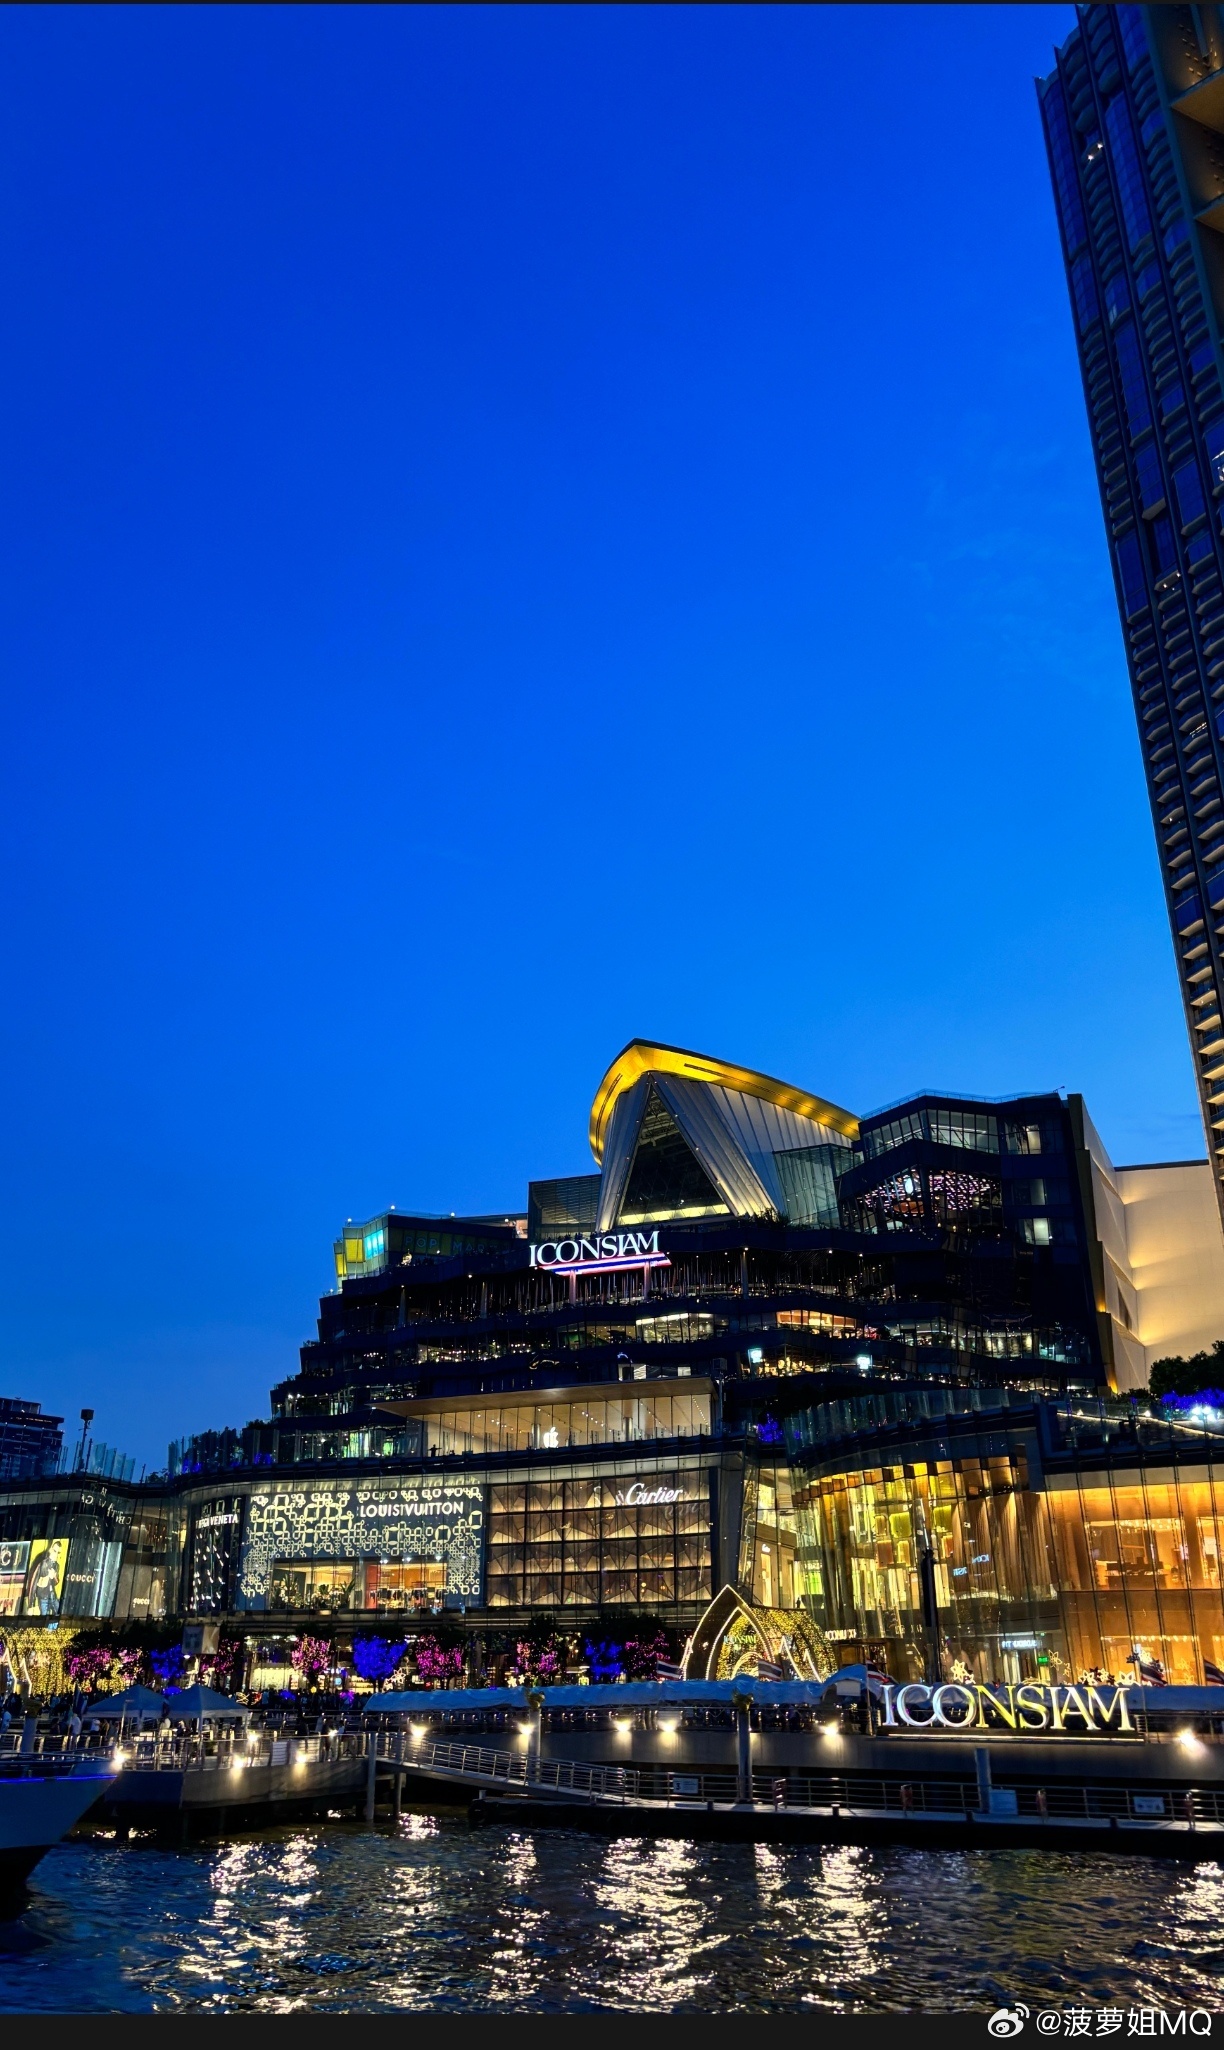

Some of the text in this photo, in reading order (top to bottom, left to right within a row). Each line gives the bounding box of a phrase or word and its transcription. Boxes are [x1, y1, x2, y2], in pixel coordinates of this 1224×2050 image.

[404, 1236, 438, 1249] POP
[529, 1230, 660, 1267] ICONSIAM
[626, 1482, 684, 1505] Cartier
[210, 1513, 239, 1526] VENETA
[360, 1501, 464, 1518] LOUIS VUITTON
[879, 1683, 1136, 1732] ICONSIAM
